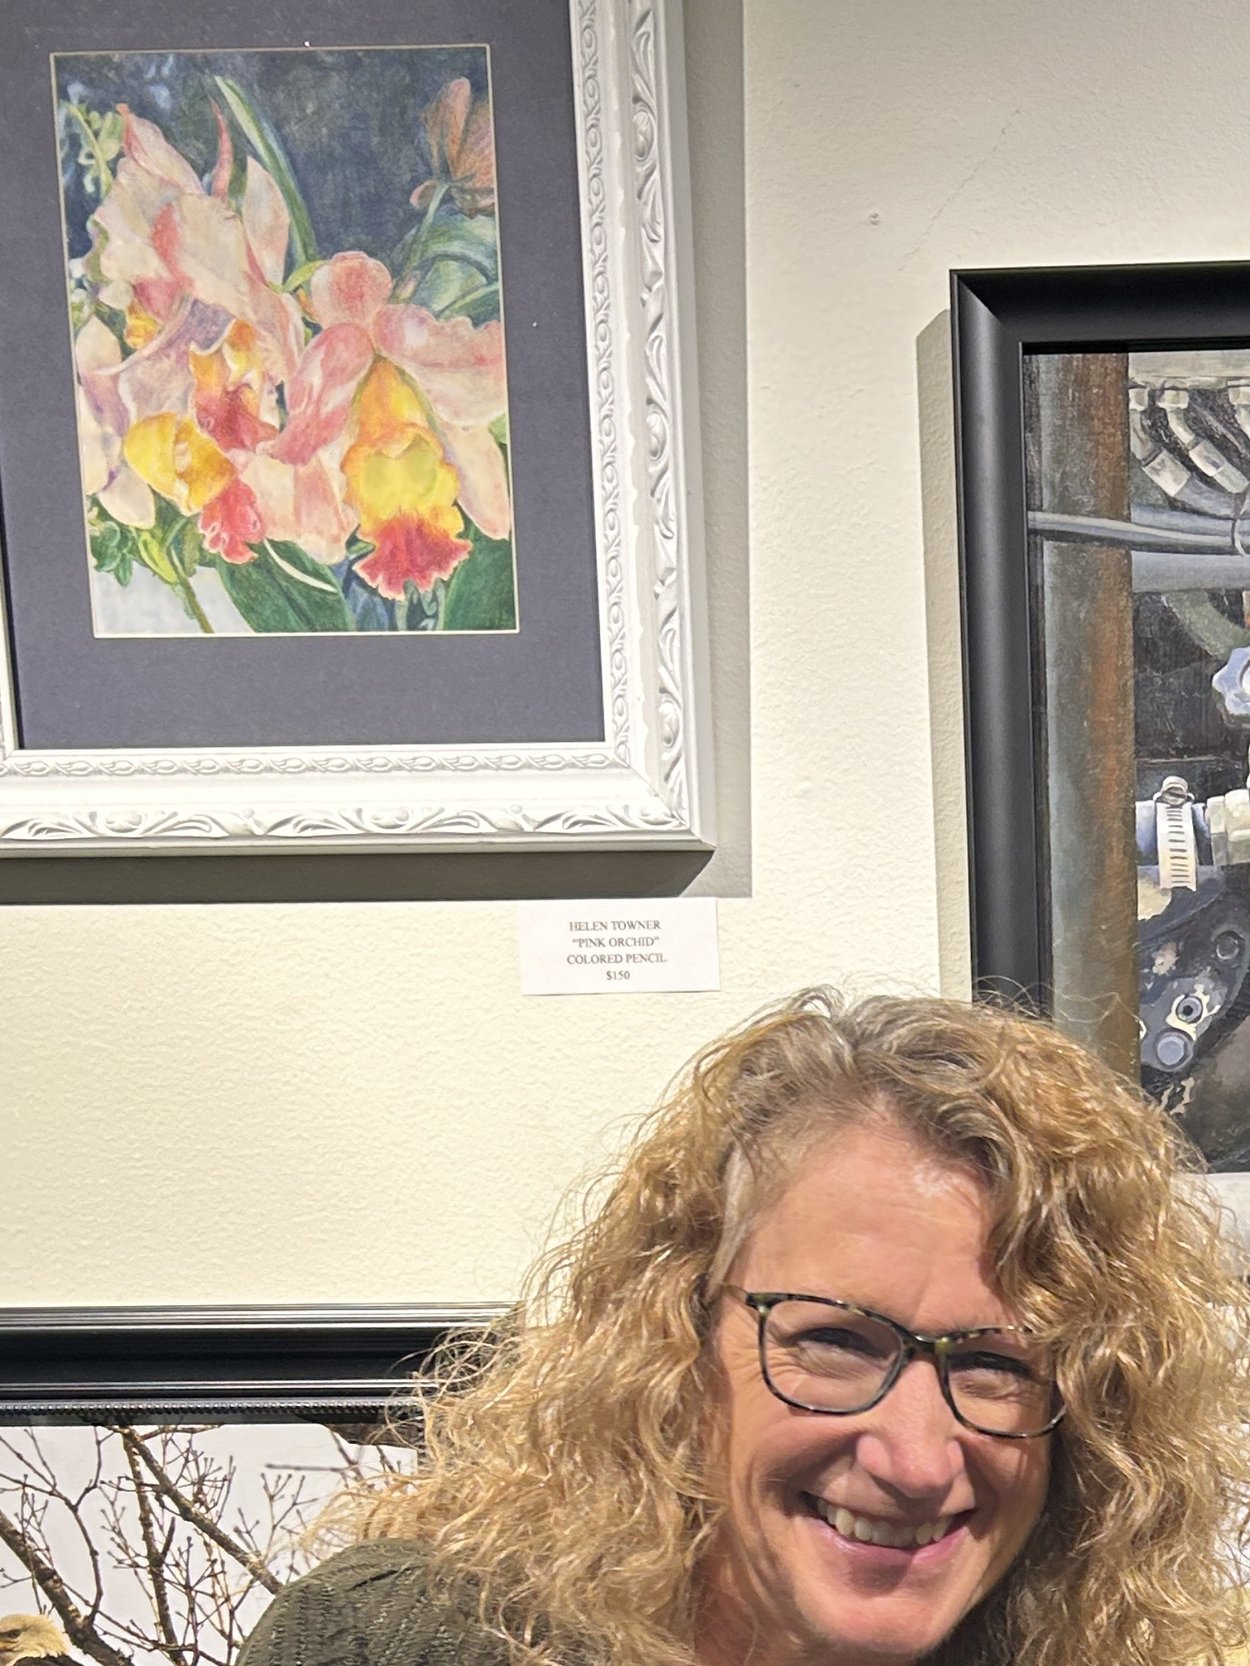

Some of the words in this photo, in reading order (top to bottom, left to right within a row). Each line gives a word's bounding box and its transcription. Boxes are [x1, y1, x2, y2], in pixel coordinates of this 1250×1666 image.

[569, 921, 608, 932] HELEN
[611, 919, 662, 931] TOWNER
[572, 937, 606, 949] "PINK
[608, 935, 660, 948] ORCHID"
[566, 953, 623, 965] COLORED
[625, 952, 668, 964] PENCIL
[605, 970, 631, 981] $150
